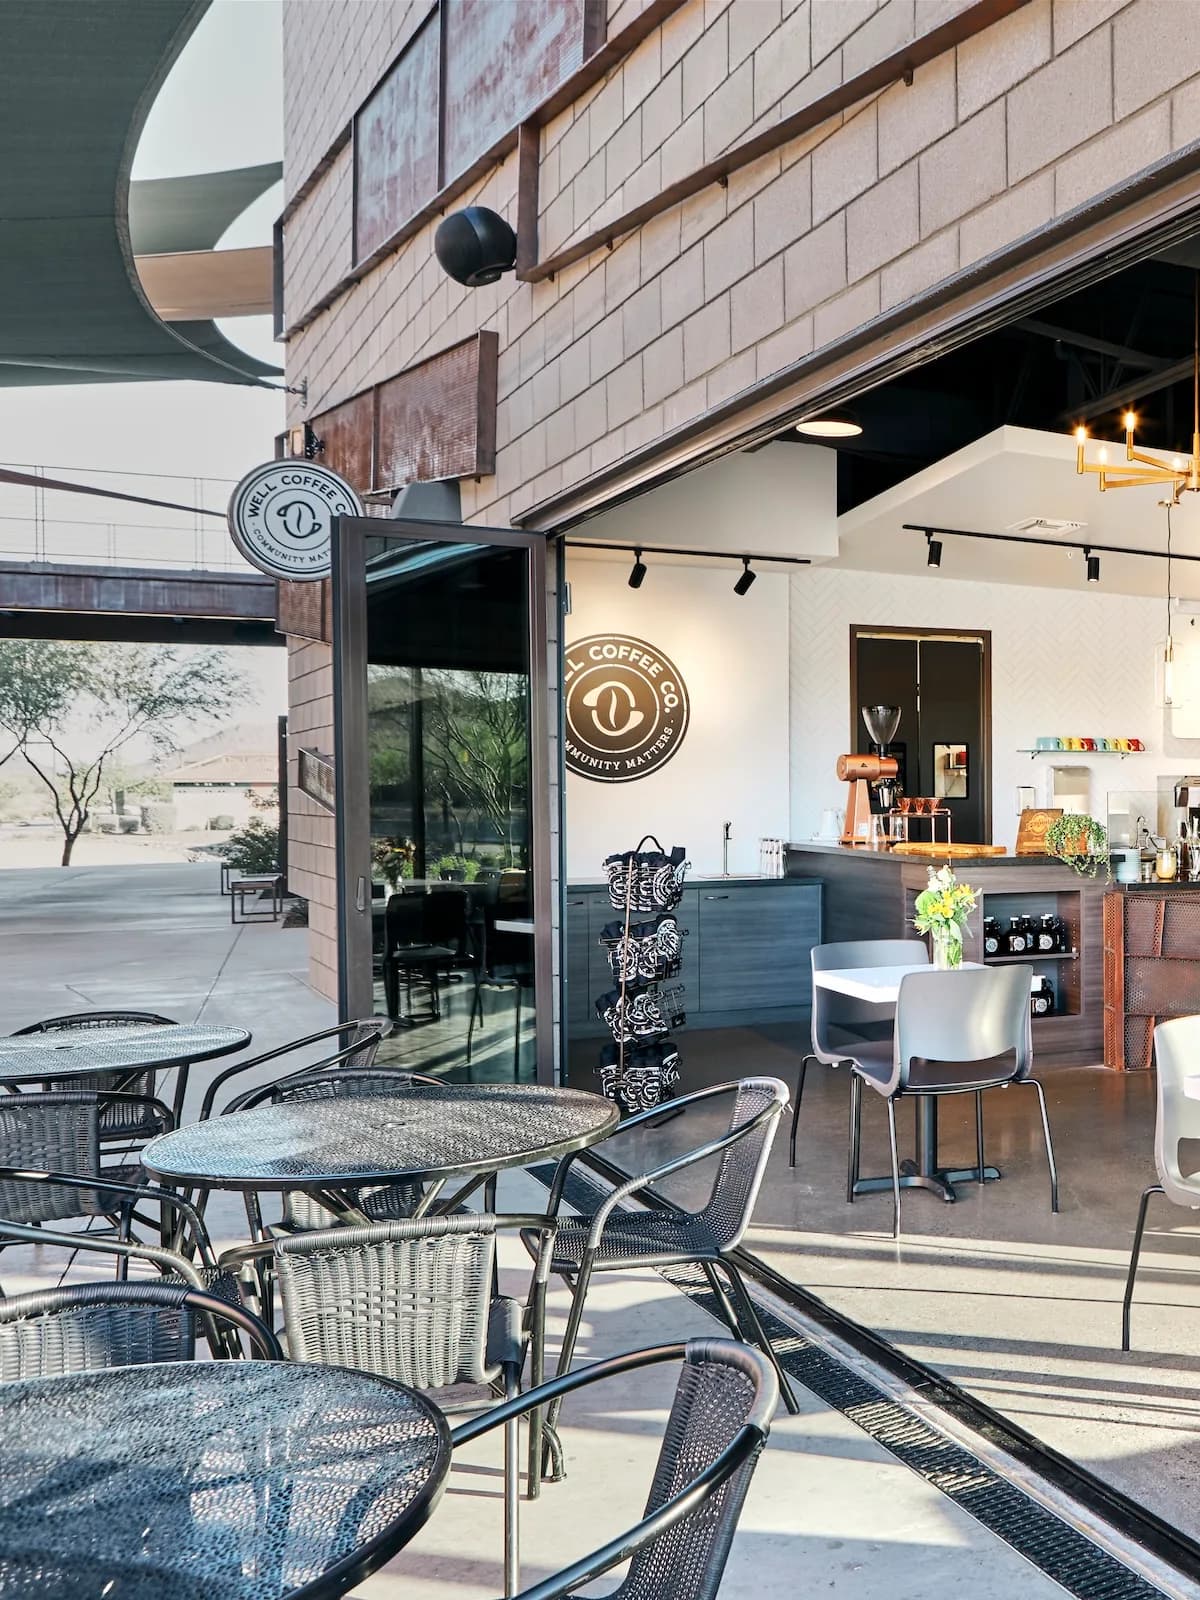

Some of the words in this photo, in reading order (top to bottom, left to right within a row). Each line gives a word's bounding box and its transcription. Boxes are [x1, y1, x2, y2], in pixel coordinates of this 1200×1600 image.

[248, 482, 278, 518] WELL
[281, 474, 338, 501] COFFEE
[253, 527, 305, 563] COMMUNITY
[588, 643, 665, 679] COFFEE
[660, 680, 679, 714] CO.
[625, 726, 673, 769] MATTERS
